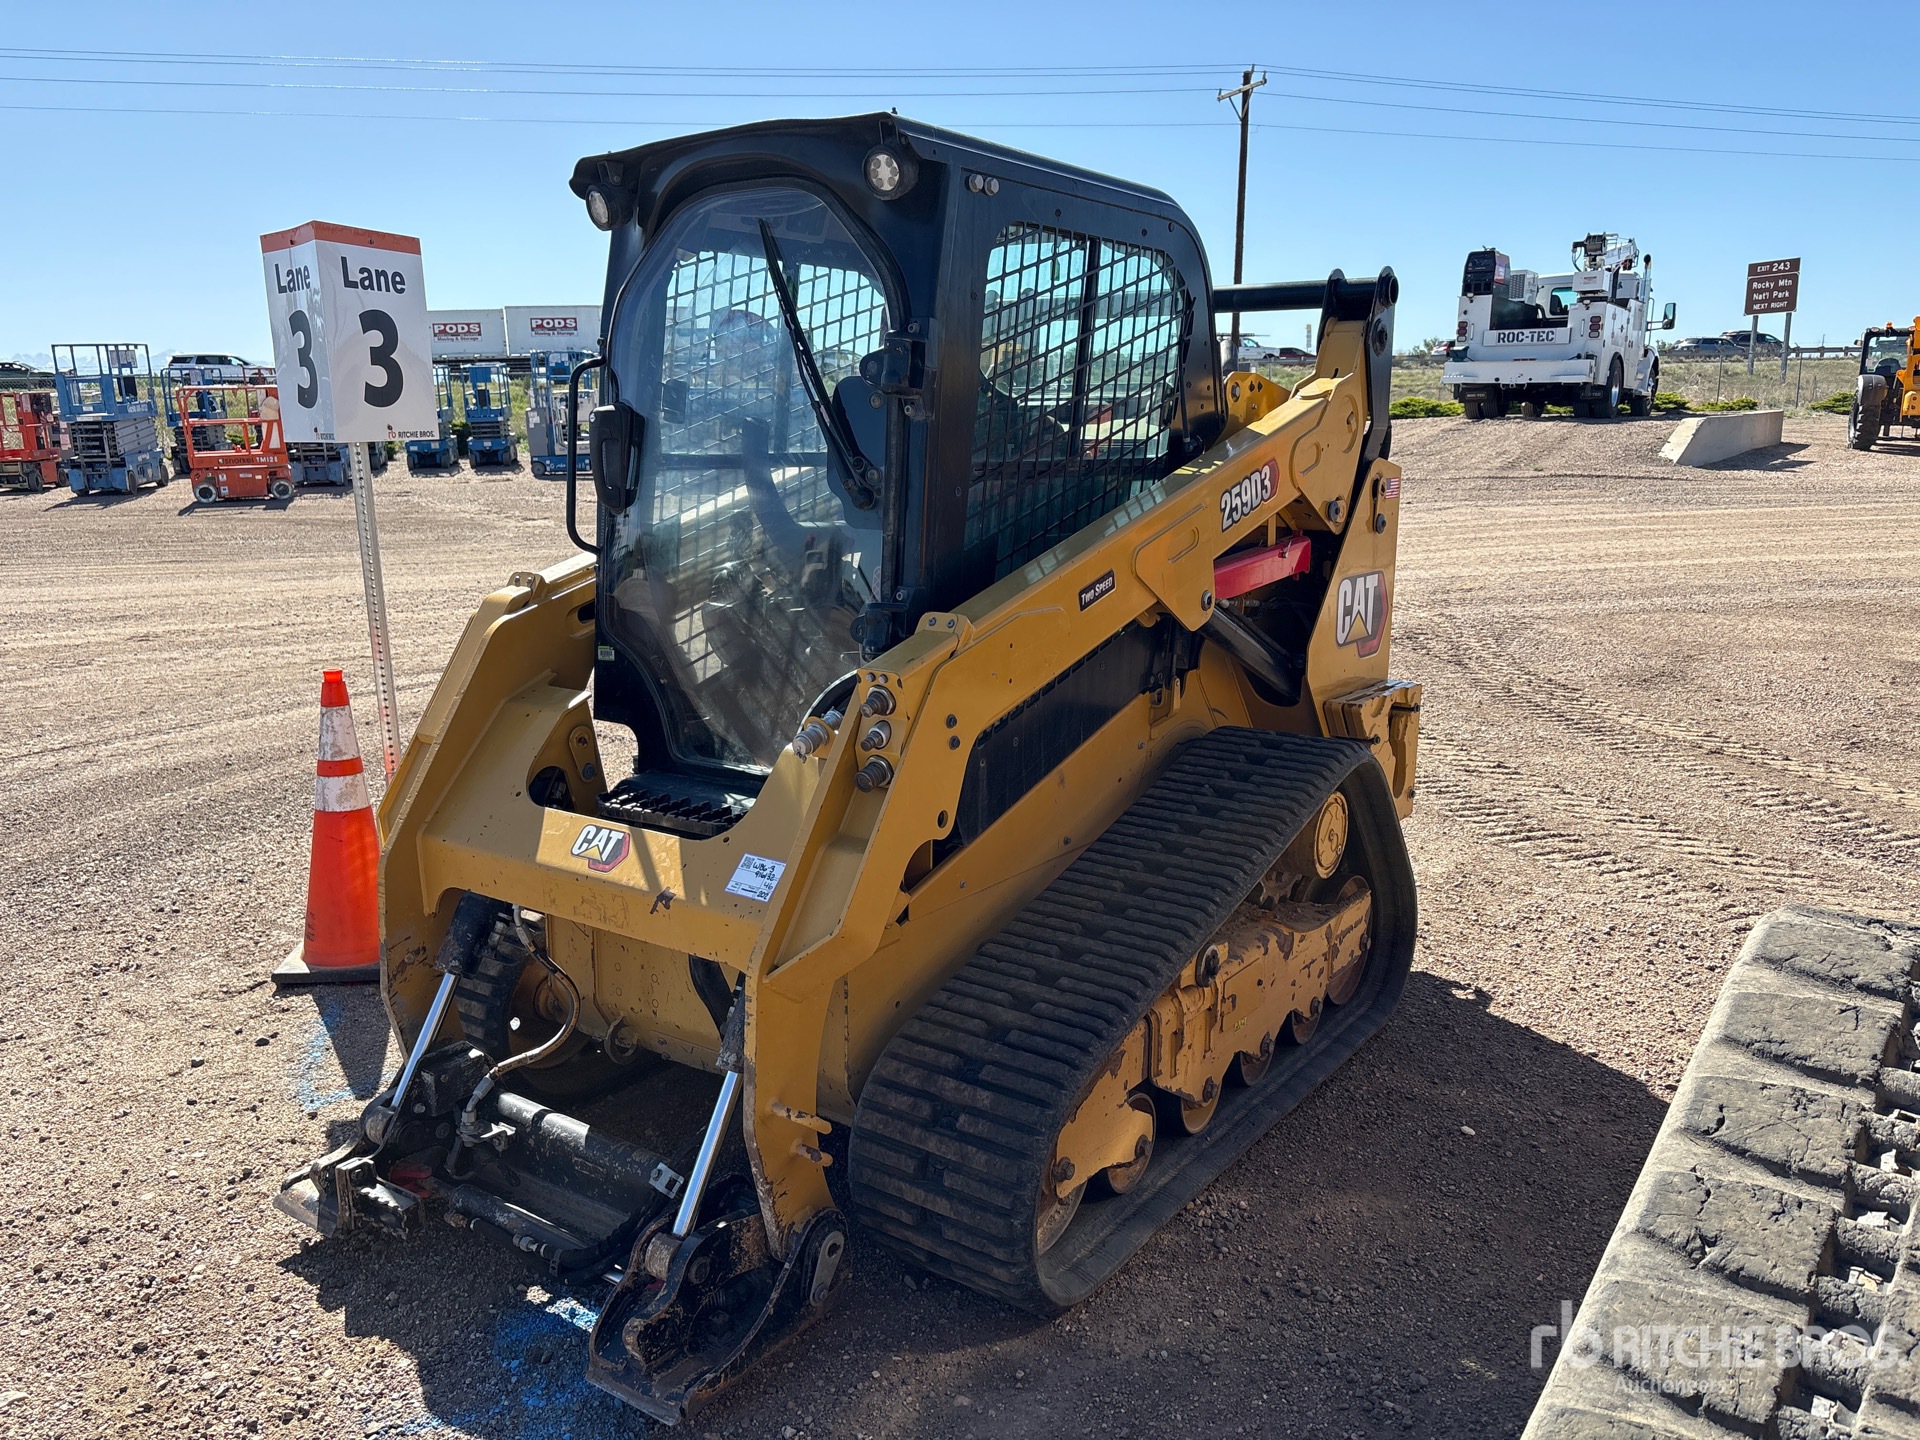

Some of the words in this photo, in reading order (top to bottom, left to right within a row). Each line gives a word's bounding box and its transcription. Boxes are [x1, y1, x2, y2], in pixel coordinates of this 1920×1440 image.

[1772, 261, 1791, 272] 243
[274, 263, 311, 294] Lane
[340, 256, 406, 294] Lane
[1752, 281, 1775, 289] Rocky
[1778, 278, 1793, 287] Mtn
[1772, 290, 1790, 299] Park
[1770, 301, 1788, 309] RIGHT
[433, 323, 480, 334] PODS
[531, 318, 576, 328] PODS
[1497, 330, 1555, 343] ROC-TEC
[288, 309, 319, 409] 3
[358, 309, 404, 408] 3
[398, 431, 418, 439] RITCHIE
[1221, 465, 1271, 530] 259D3
[1336, 574, 1379, 645] CAT
[572, 825, 625, 862] CAT
